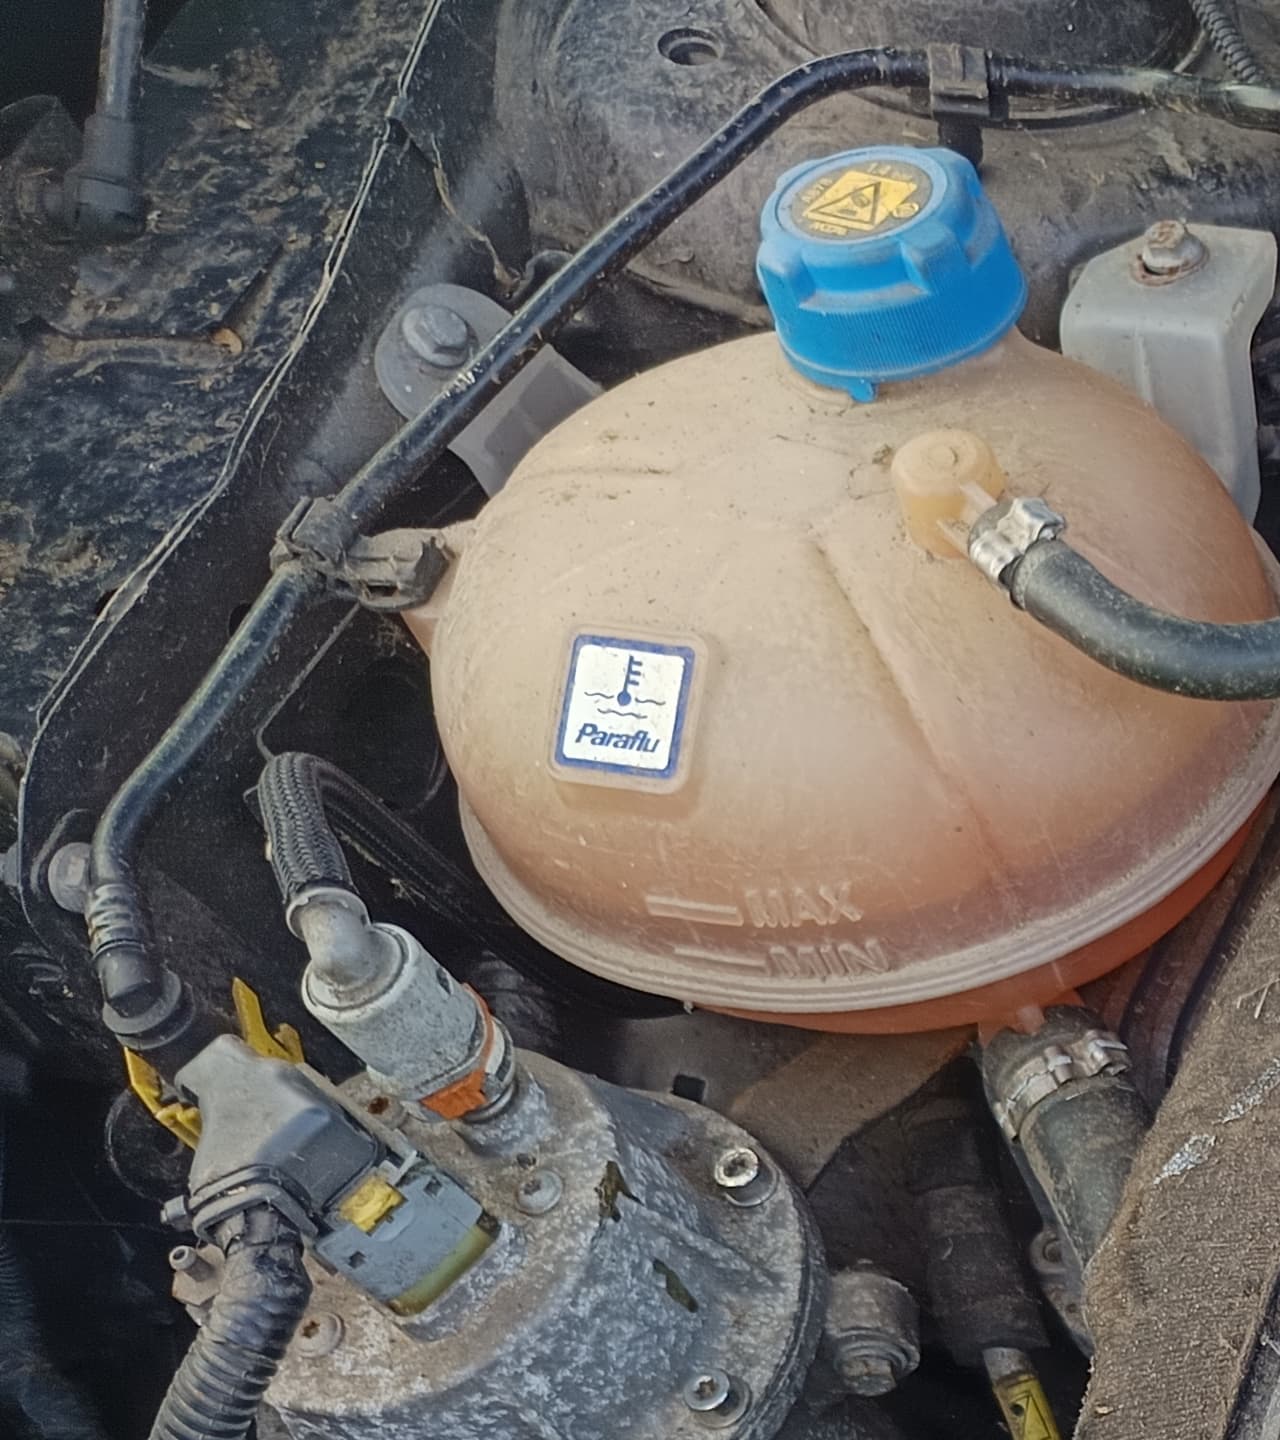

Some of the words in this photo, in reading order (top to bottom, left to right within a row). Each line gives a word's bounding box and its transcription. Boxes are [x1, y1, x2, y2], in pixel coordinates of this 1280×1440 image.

[575, 723, 660, 753] Paraflu
[745, 883, 864, 928] MAX
[767, 939, 892, 978] MIN
